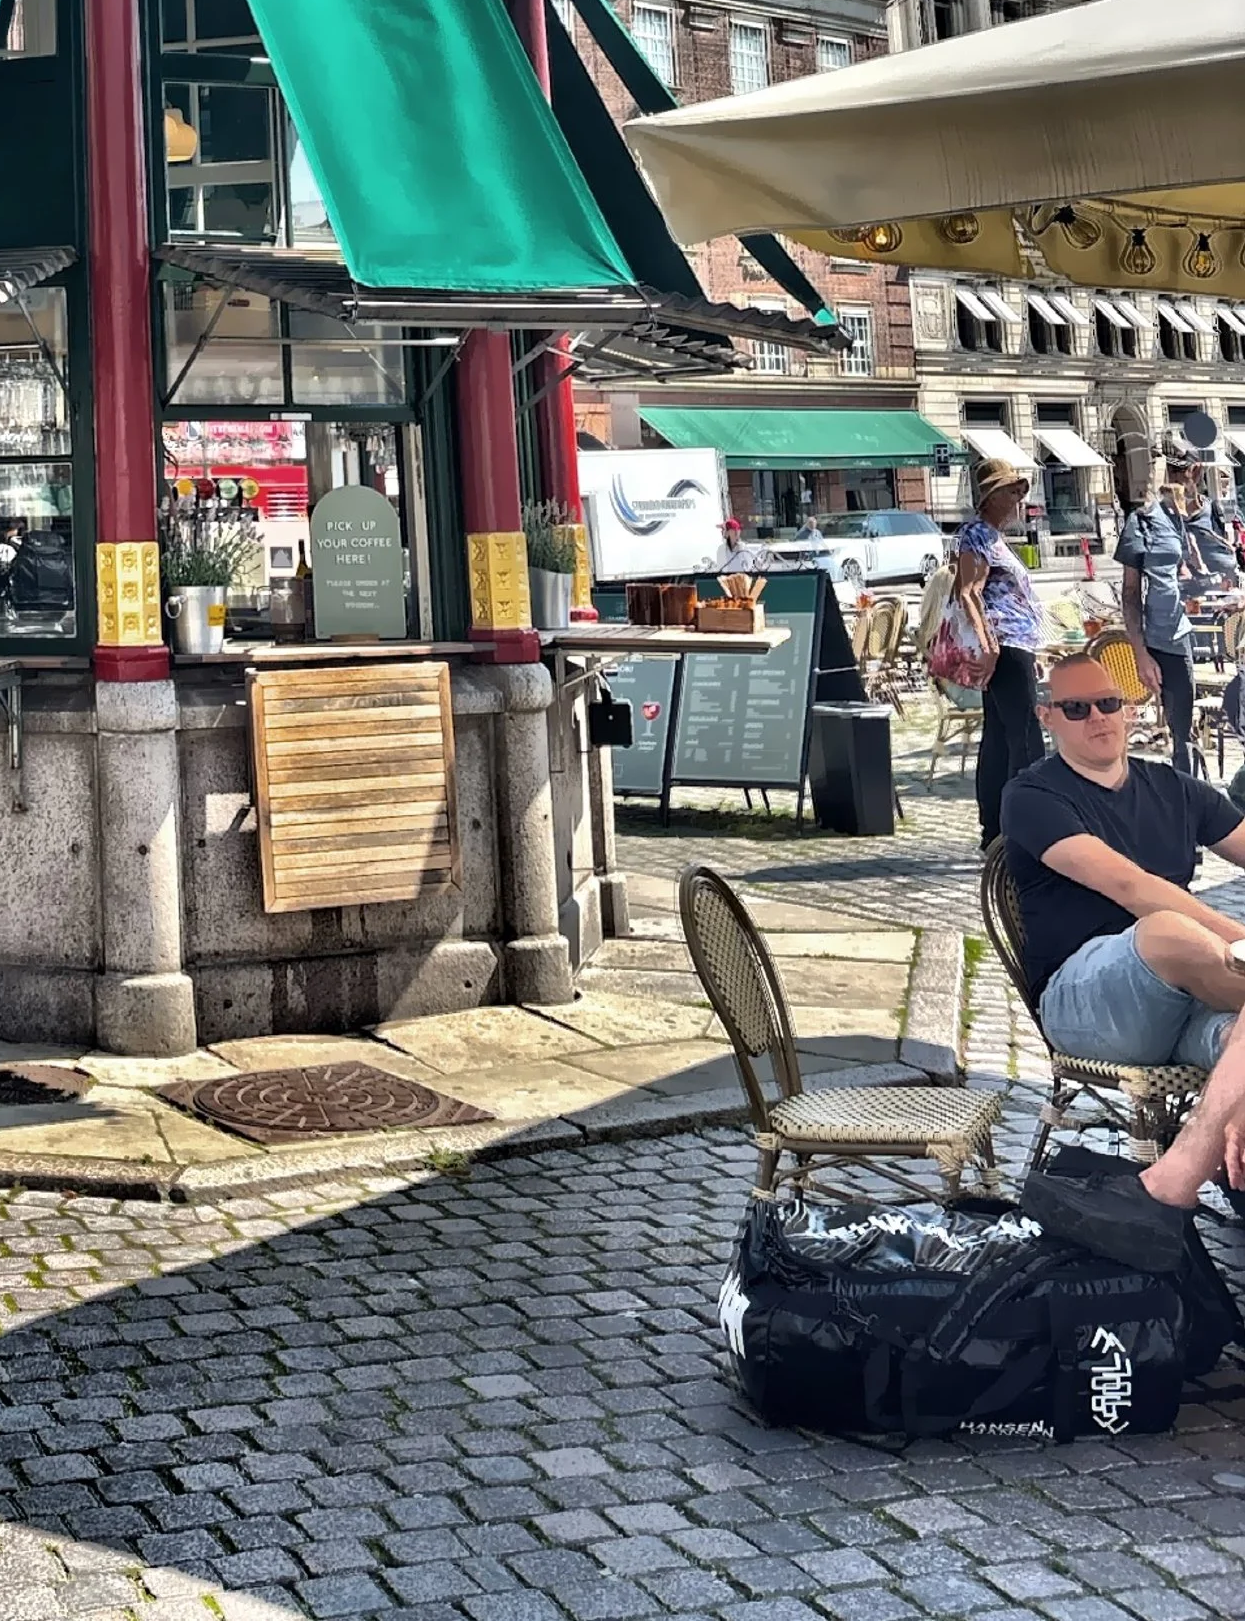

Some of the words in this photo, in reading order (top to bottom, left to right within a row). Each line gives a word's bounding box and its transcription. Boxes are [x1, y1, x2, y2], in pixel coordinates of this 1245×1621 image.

[326, 521, 353, 531] PICK
[362, 520, 376, 530] UP
[317, 538, 347, 549] YOUR
[350, 537, 392, 548] COFFEE
